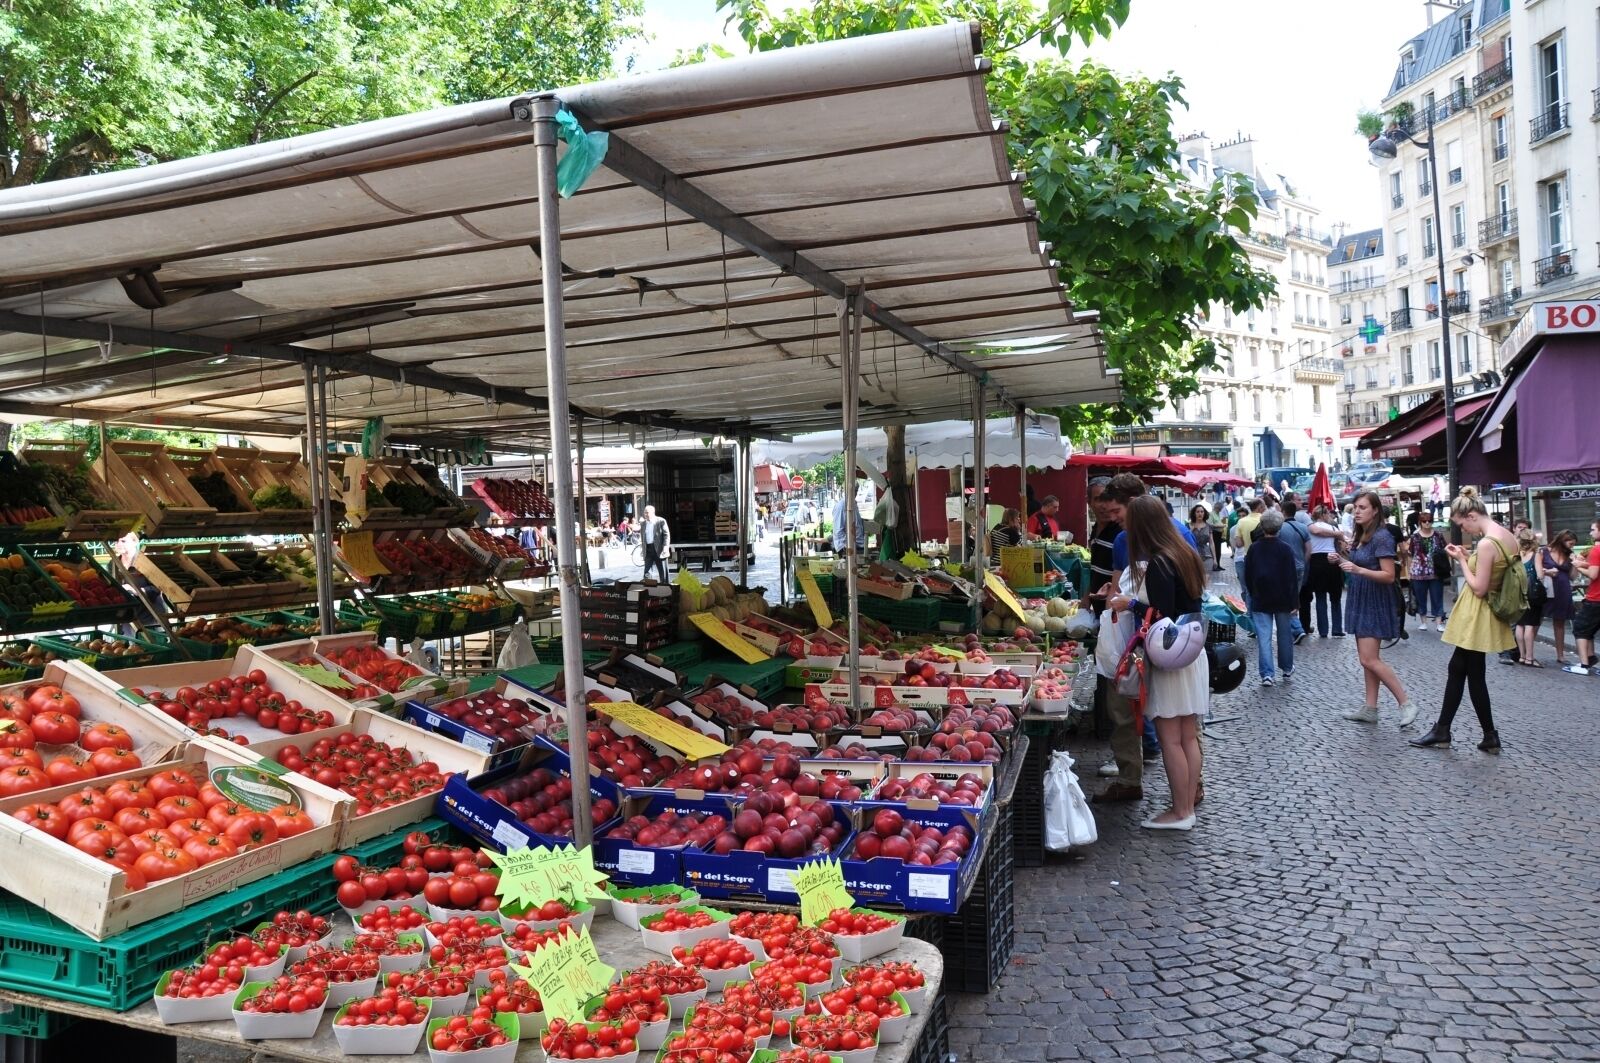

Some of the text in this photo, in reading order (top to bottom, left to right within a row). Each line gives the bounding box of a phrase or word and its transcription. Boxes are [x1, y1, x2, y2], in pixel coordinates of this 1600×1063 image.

[1545, 304, 1600, 329] BO
[458, 805, 473, 818] del
[474, 814, 496, 833] Segr
[924, 820, 950, 829] Segre
[704, 872, 720, 881] del
[723, 873, 755, 884] Segre
[859, 881, 892, 891] Segre
